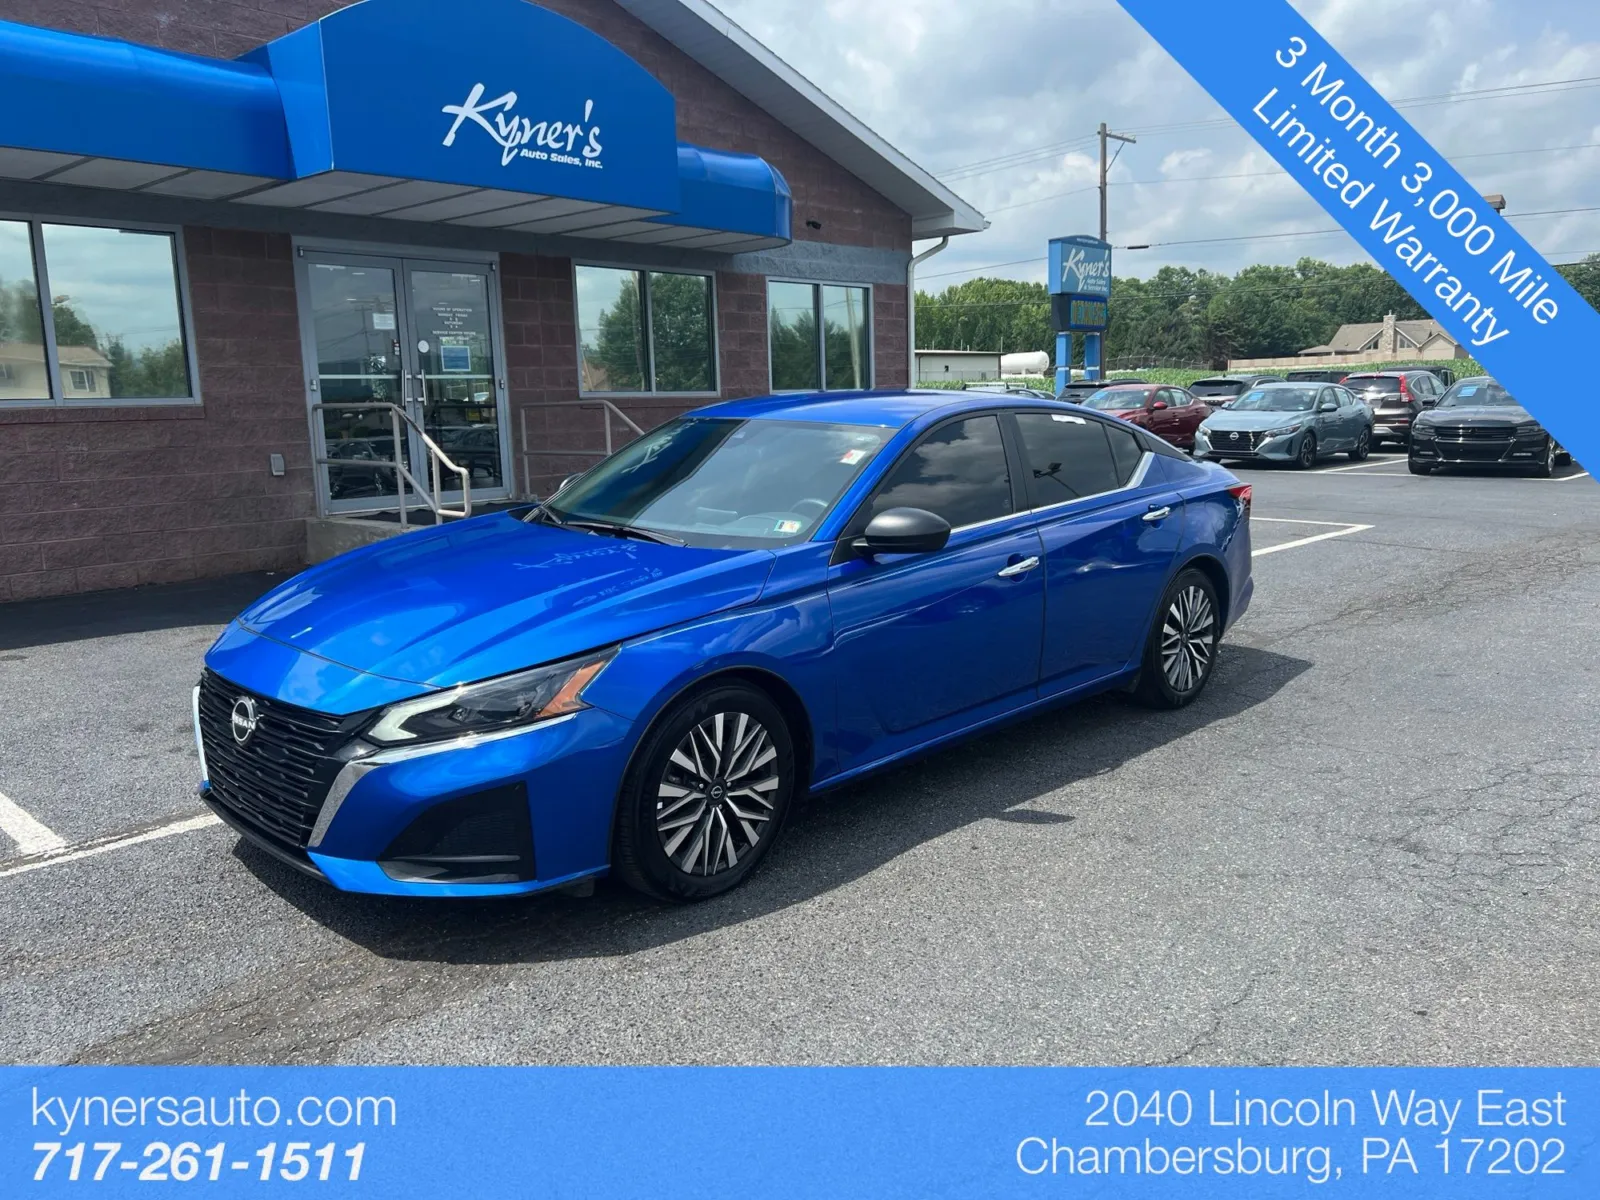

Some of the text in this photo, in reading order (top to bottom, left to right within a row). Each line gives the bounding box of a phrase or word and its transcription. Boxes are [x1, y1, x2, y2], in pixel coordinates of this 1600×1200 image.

[441, 82, 603, 166] Kyner's
[520, 148, 603, 169] Auto Sales, Inc.
[1062, 247, 1110, 292] Kyner's
